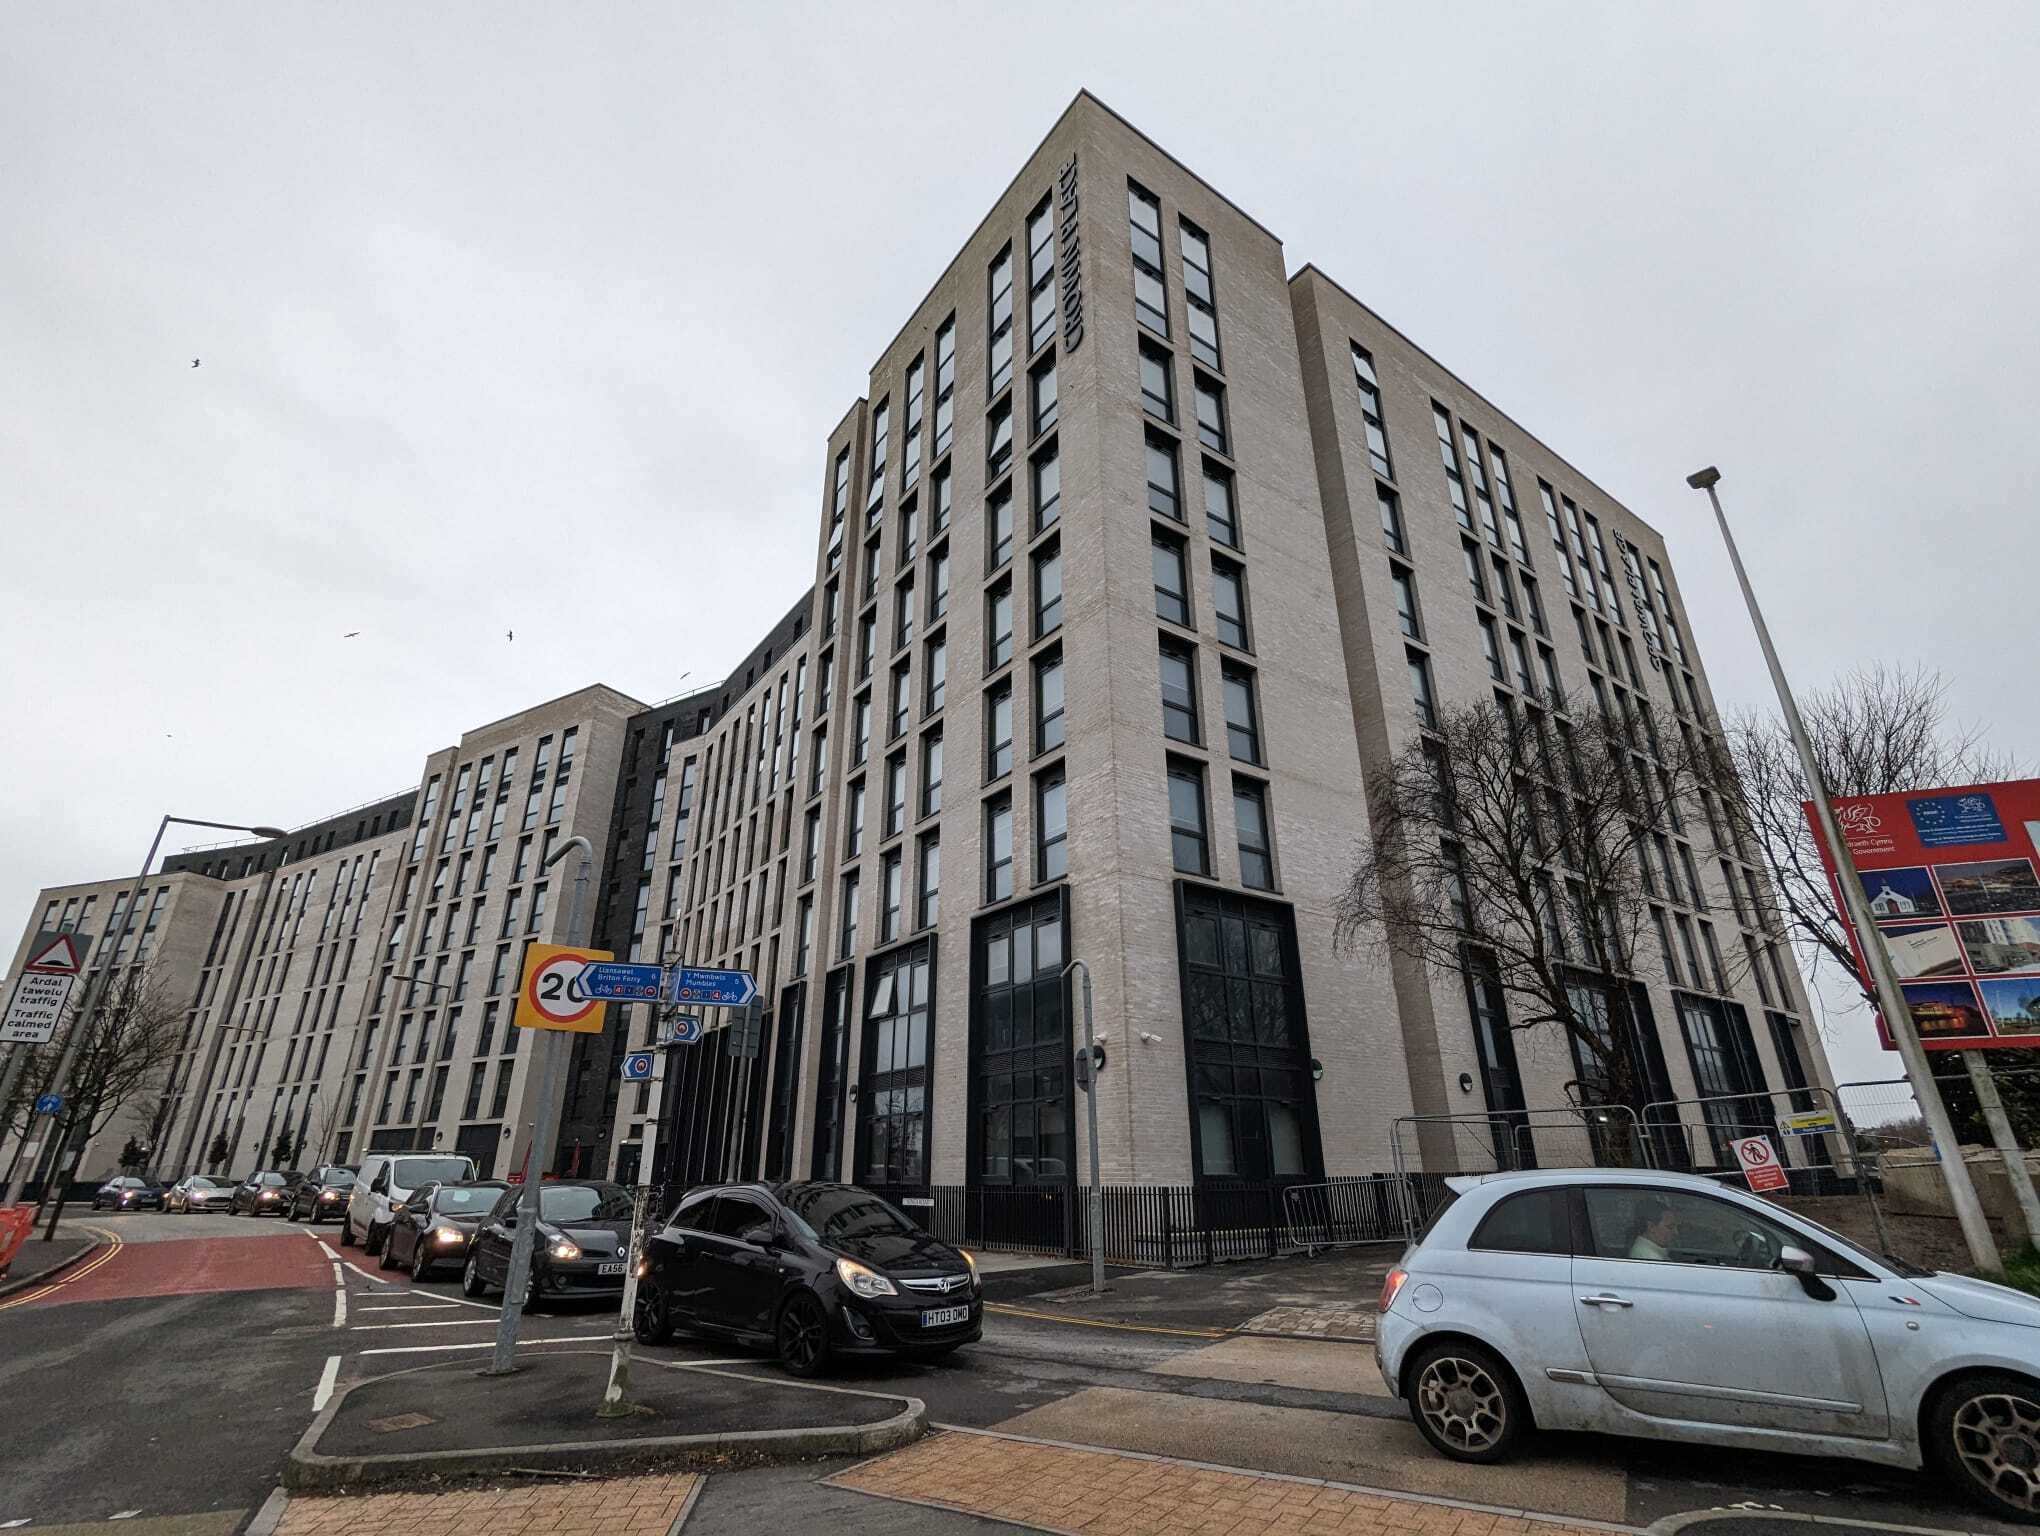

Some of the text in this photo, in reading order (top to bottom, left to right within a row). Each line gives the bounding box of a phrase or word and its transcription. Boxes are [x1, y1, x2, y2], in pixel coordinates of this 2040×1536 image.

[1059, 152, 1084, 353] CROWN PLACE
[1853, 847, 1896, 855] Government
[31, 977, 63, 986] Ardal
[623, 975, 641, 983] Ferry
[22, 986, 63, 996] tawelu
[20, 995, 58, 1006] traffig
[14, 1009, 53, 1019] Traffic
[8, 1019, 52, 1029] calmed
[928, 1310, 951, 1325] HT03
